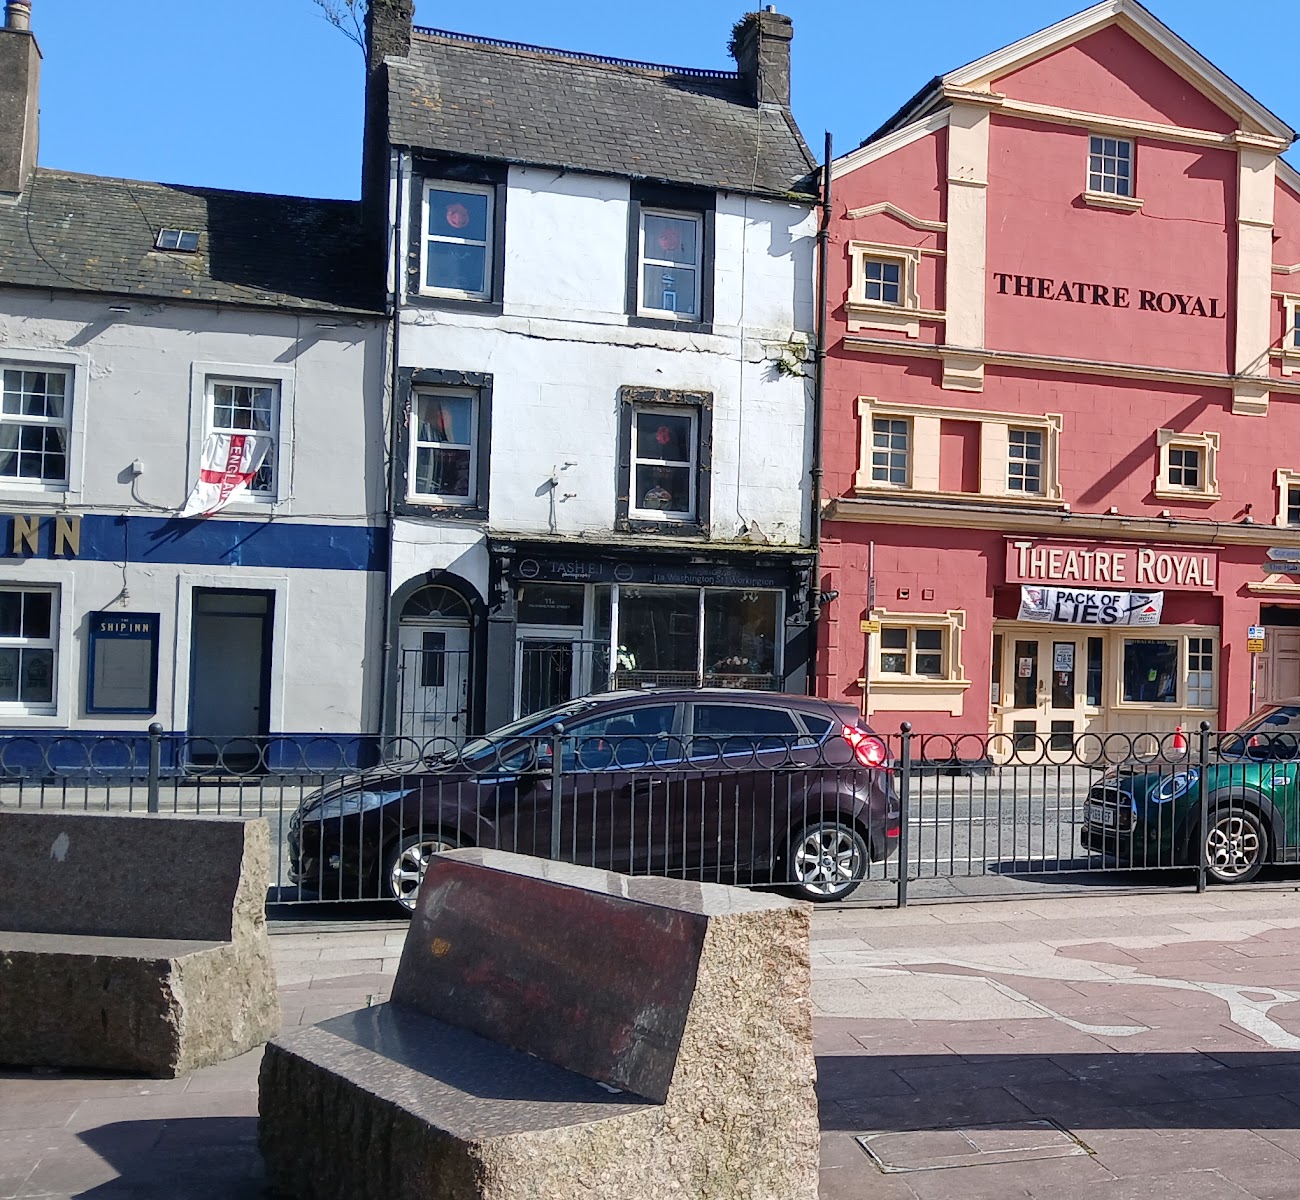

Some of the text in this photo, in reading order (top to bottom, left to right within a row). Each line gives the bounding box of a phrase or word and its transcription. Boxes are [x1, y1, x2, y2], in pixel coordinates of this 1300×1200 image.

[993, 272, 1226, 319] THEATRE ROYAL
[220, 446, 242, 501] ENGLAN
[13, 515, 81, 556] NN
[550, 562, 584, 574] TASH
[1014, 541, 1215, 586] THEATRE ROYAL
[1269, 563, 1283, 571] The
[667, 574, 715, 584] Washington
[729, 577, 774, 586] Workington
[1056, 591, 1121, 606] PACK OF
[1053, 602, 1118, 624] LIES
[101, 623, 149, 632] SHIP INN
